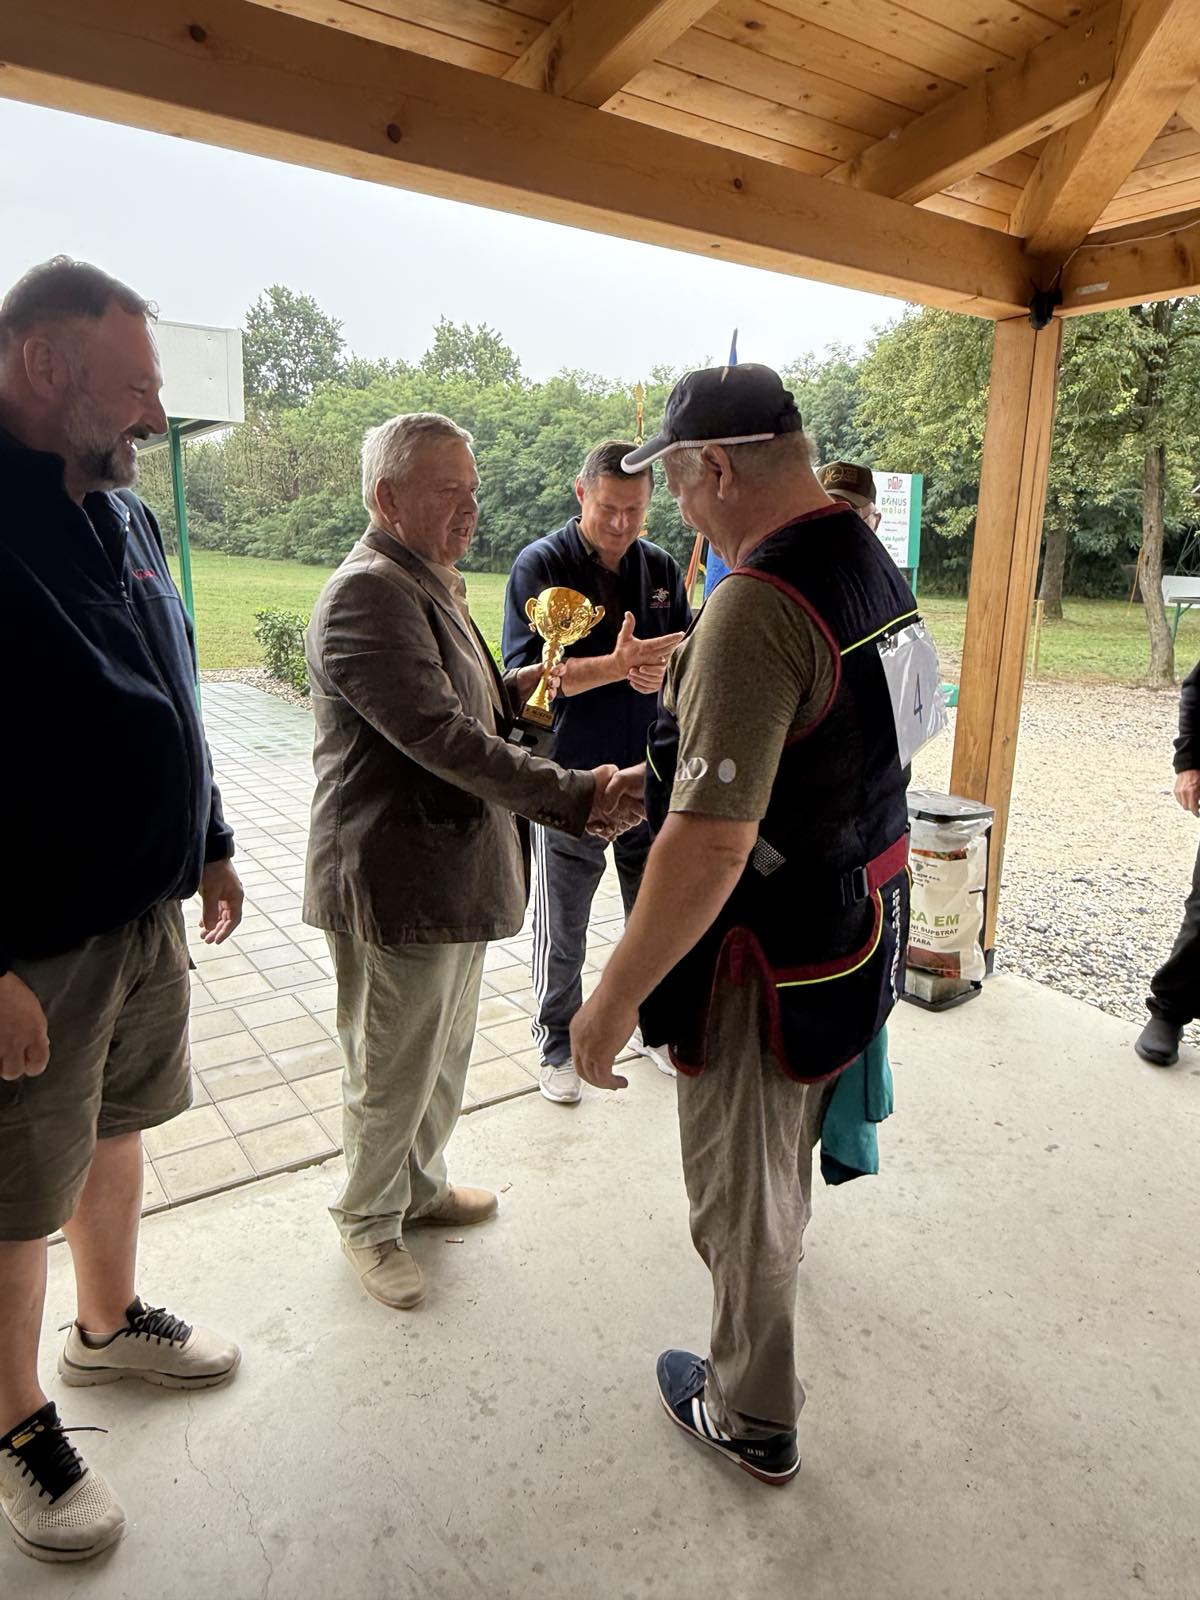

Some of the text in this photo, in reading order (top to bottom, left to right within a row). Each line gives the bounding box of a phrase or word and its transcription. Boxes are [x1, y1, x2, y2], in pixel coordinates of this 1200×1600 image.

[913, 672, 923, 724] 4
[934, 914, 960, 927] EM
[921, 927, 958, 936] SUPSTRAT
